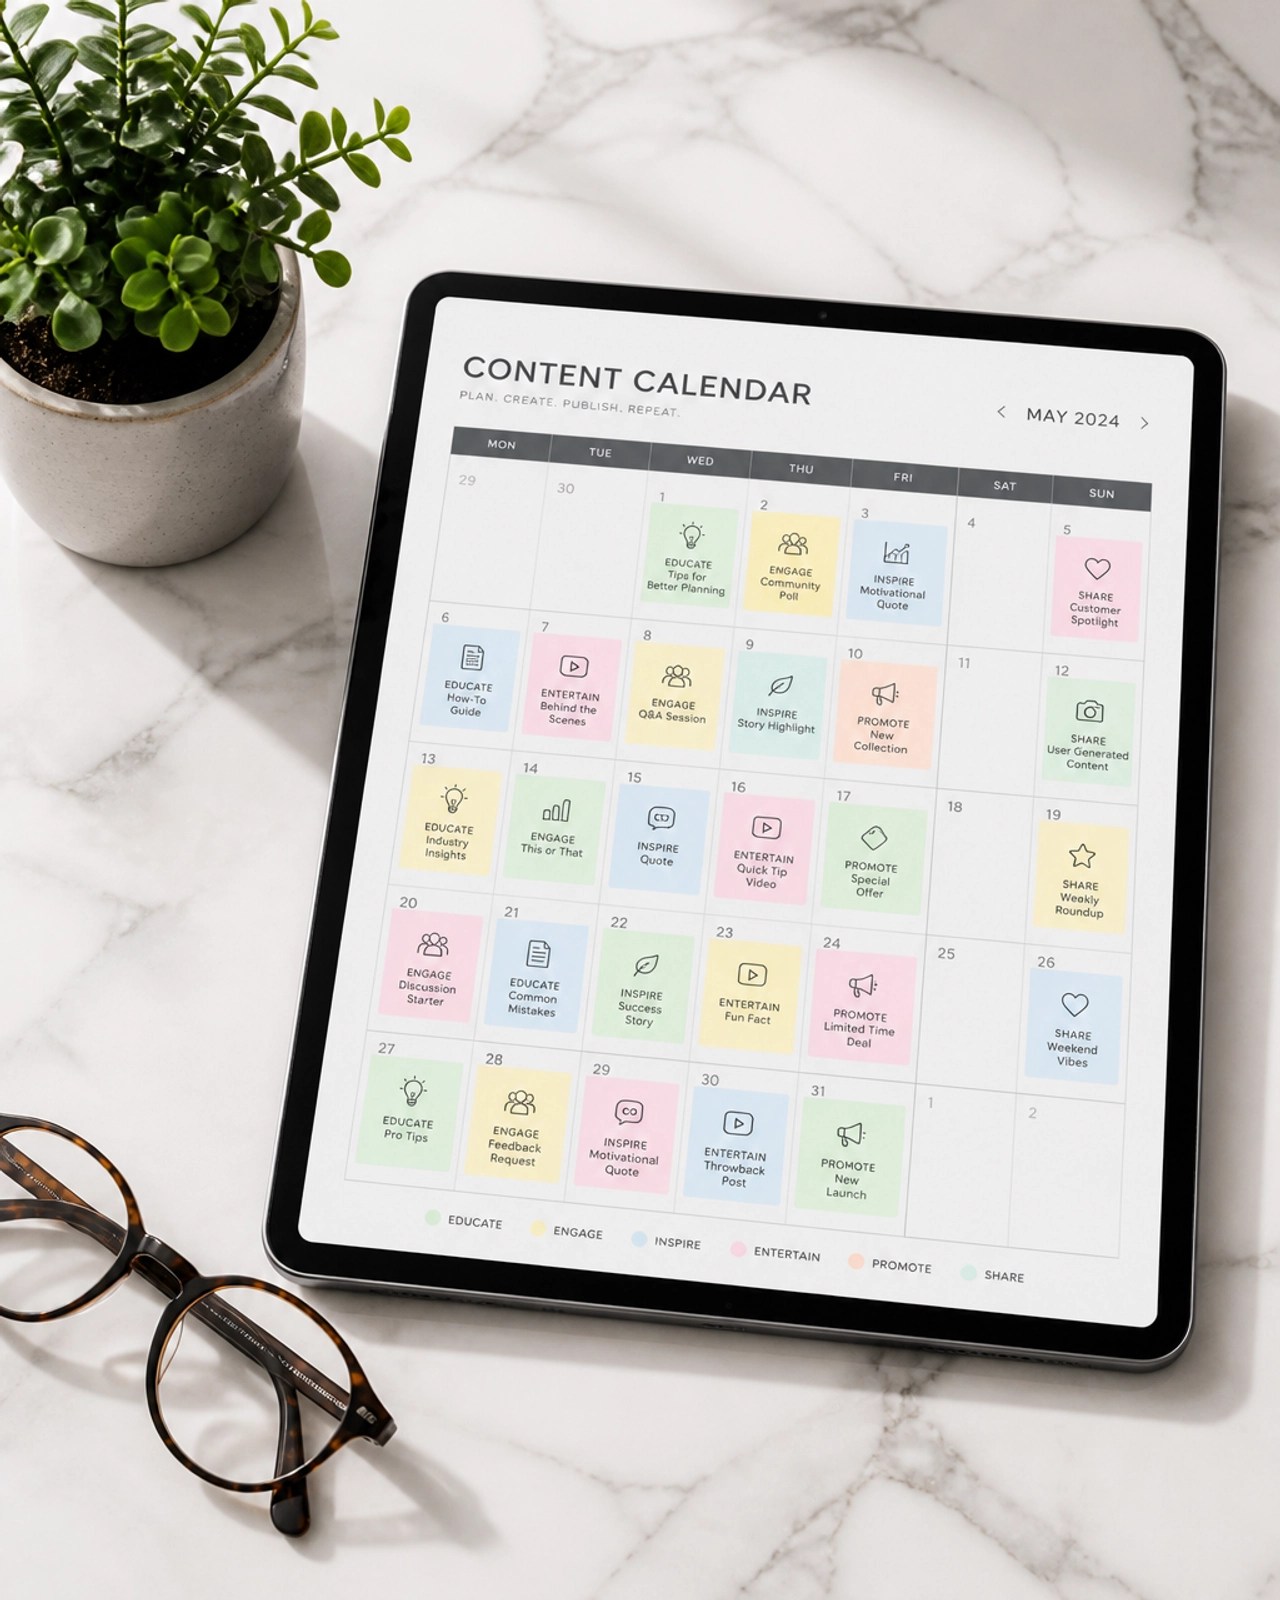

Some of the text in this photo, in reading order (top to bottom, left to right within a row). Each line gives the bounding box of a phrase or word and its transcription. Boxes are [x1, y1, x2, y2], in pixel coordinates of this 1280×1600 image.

[463, 355, 812, 406] CONTENT CALENDAR
[459, 389, 681, 418] PLAN. CREATE. PUBLISH. REPEAT.
[1026, 407, 1120, 428] MAY 2024
[487, 439, 516, 450] MON
[589, 447, 612, 458] TUE
[687, 455, 714, 467] WED
[789, 463, 814, 475] THU
[458, 474, 476, 486] 29
[893, 472, 913, 483] FRI
[557, 482, 575, 495] 30
[993, 480, 1017, 491] SAT
[659, 491, 665, 502] 1
[1089, 488, 1115, 499] SUN
[759, 499, 769, 511] 2
[861, 507, 869, 519] 3
[967, 517, 976, 529] 4
[1063, 524, 1072, 536] 5
[664, 557, 713, 570] EDUCATE
[667, 569, 707, 582] Tips for
[768, 565, 814, 578] ENGAGE
[759, 576, 822, 593] Community
[873, 574, 915, 588] INSPIRE
[646, 579, 726, 598] Better Planning
[778, 590, 799, 601] Poll
[859, 585, 927, 600] Motivational
[1078, 590, 1114, 603] SHARE
[876, 598, 909, 611] Quote
[1069, 602, 1122, 616] Customer
[441, 611, 450, 623] 6
[541, 620, 550, 633] 7
[642, 629, 652, 642] 8
[745, 638, 755, 651] 9
[848, 647, 864, 660] 10
[958, 657, 970, 669] 11
[1055, 664, 1070, 677] 12
[444, 679, 494, 693] EDUCATE
[446, 692, 487, 706] How-To
[540, 687, 601, 703] ENTERTAIN
[449, 704, 482, 718] Guide
[539, 700, 598, 715] Behind the
[651, 697, 696, 711] ENGAGE
[548, 713, 587, 727] Scenes
[638, 708, 707, 725] Q&A Session
[756, 707, 798, 721] INSPIRE
[737, 717, 816, 736] Story Highlight
[857, 715, 910, 730] PROMOTE
[869, 729, 895, 741] New
[1070, 733, 1107, 747] SHARE
[853, 740, 908, 754] Collection
[1047, 744, 1130, 761] User Generated
[421, 752, 437, 765] 13
[1065, 758, 1109, 772] Content
[523, 762, 538, 775] 14
[627, 771, 642, 784] 15
[731, 781, 747, 794] 16
[837, 790, 852, 802] 17
[947, 800, 963, 813] 18
[1046, 808, 1062, 822] 19
[424, 821, 475, 836] EDUCATE
[425, 834, 470, 851] Industry
[530, 831, 576, 845] ENGAGE
[424, 847, 467, 862] Insights
[520, 842, 584, 858] This or That
[637, 841, 680, 854] INSPIRE
[639, 853, 674, 867] Quote
[733, 849, 795, 865] ENTERTAIN
[736, 862, 788, 879] Quick Tip
[844, 859, 898, 874] PROMOTE
[745, 877, 777, 890] Video
[850, 873, 891, 887] Special
[1062, 878, 1099, 892] SHARE
[855, 886, 884, 899] Offer
[399, 896, 418, 909] 20
[504, 905, 519, 919] 21
[1054, 904, 1104, 921] Roundup
[610, 916, 628, 929] 22
[716, 925, 734, 939] 23
[822, 936, 841, 950] 24
[937, 946, 956, 960] 25
[1037, 955, 1056, 969] 26
[406, 967, 452, 982] ENGAGE
[398, 979, 457, 995] Discussion
[509, 977, 561, 992] EDUCATE
[406, 993, 445, 1007] Starter
[508, 989, 558, 1005] Common
[620, 988, 663, 1002] INSPIRE
[507, 1003, 556, 1018] Mistakes
[617, 1000, 663, 1015] Success
[718, 997, 781, 1013] ENTERTAIN
[624, 1014, 654, 1030] Story
[724, 1010, 771, 1025] Fun Fact
[833, 1008, 888, 1024] PROMOTE
[823, 1021, 896, 1038] Limited Time
[1054, 1028, 1092, 1042] SHARE
[377, 1042, 396, 1055] 27
[846, 1036, 872, 1049] Deal
[1046, 1041, 1099, 1056] Weekend
[485, 1052, 503, 1066] 28
[1056, 1055, 1089, 1069] Vibes
[592, 1063, 611, 1077] 29
[701, 1073, 720, 1087] 30
[810, 1084, 825, 1097] 31
[928, 1096, 933, 1109] 1
[1028, 1107, 1037, 1119] 2
[382, 1115, 434, 1130] EDUCATE
[383, 1128, 429, 1144] Pro Tips
[492, 1125, 540, 1140] ENGAGE
[487, 1138, 542, 1154] Feedback
[603, 1137, 648, 1152] INSPIRE
[489, 1152, 536, 1168] Request
[588, 1148, 659, 1166] Motivational
[704, 1146, 767, 1163] ENTERTAIN
[604, 1164, 640, 1178] Quote
[703, 1159, 766, 1176] Throwback
[820, 1157, 876, 1173] PROMOTE
[721, 1174, 747, 1189] Post
[834, 1173, 860, 1186] New
[826, 1186, 868, 1200] Launch
[448, 1214, 503, 1230] EDUCATE
[553, 1225, 603, 1240] ENGAGE
[654, 1236, 702, 1251] INSPIRE
[753, 1246, 821, 1263] ENTERTAIN
[872, 1258, 932, 1275] PROMOTE
[984, 1269, 1025, 1284] SHARE
